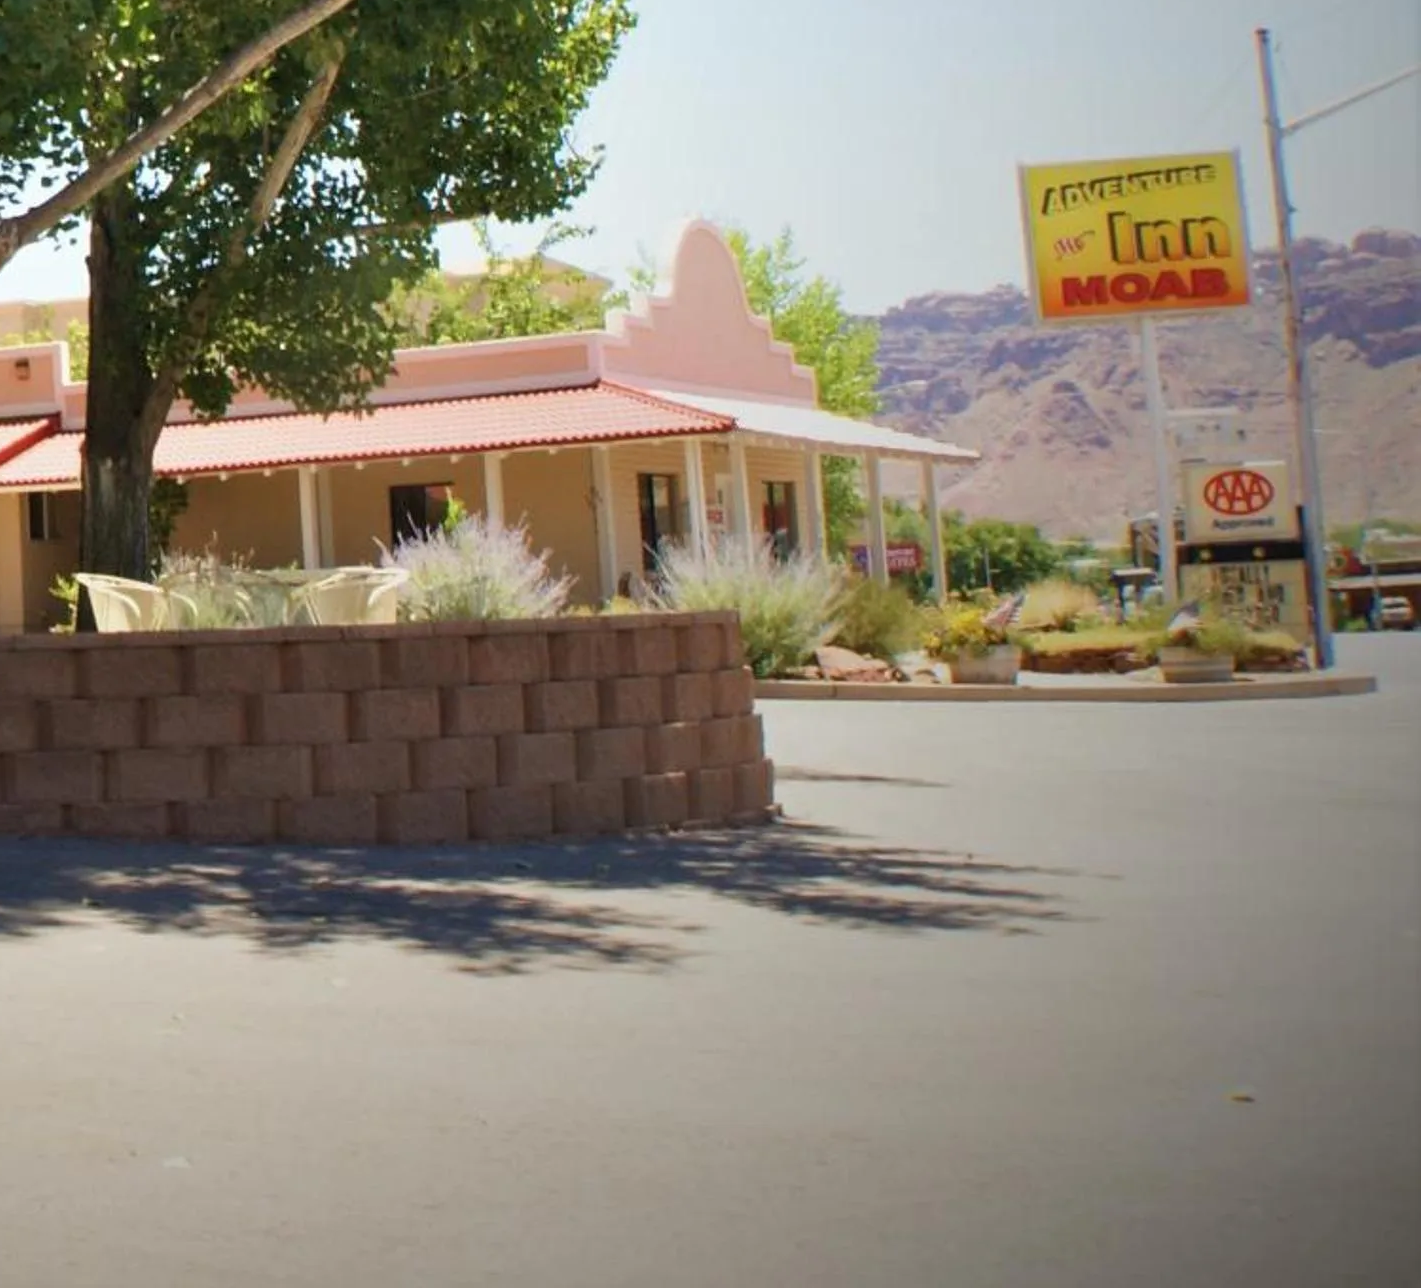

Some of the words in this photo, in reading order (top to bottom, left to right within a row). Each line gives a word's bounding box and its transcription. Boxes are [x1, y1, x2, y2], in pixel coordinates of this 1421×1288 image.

[1041, 165, 1216, 215] ADVENTURE
[1107, 212, 1231, 264] Inn
[1061, 268, 1230, 307] MOAB
[1208, 470, 1272, 515] AAA
[1213, 518, 1274, 531] Approved
